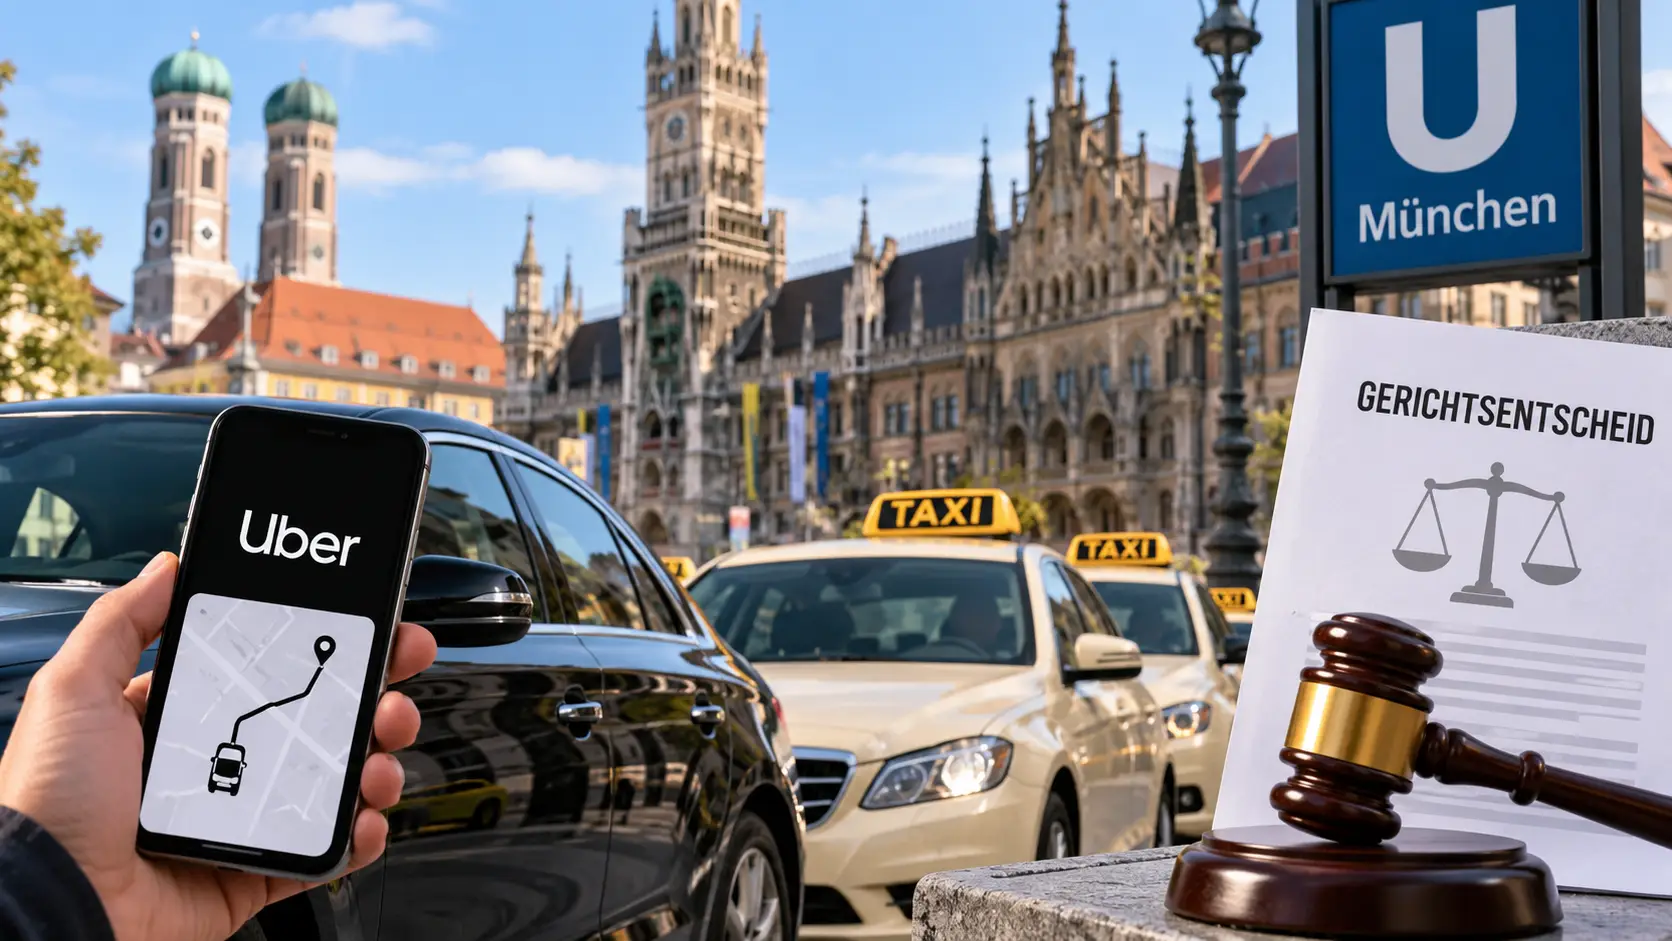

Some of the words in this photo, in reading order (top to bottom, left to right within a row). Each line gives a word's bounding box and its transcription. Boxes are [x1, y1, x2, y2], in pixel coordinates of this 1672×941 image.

[1385, 5, 1517, 173] U
[1359, 189, 1556, 243] München
[1357, 380, 1655, 445] GERICHTSENTSCHEID
[239, 509, 361, 567] Uber
[890, 497, 982, 528] TAXI
[1083, 539, 1149, 560] TAXI
